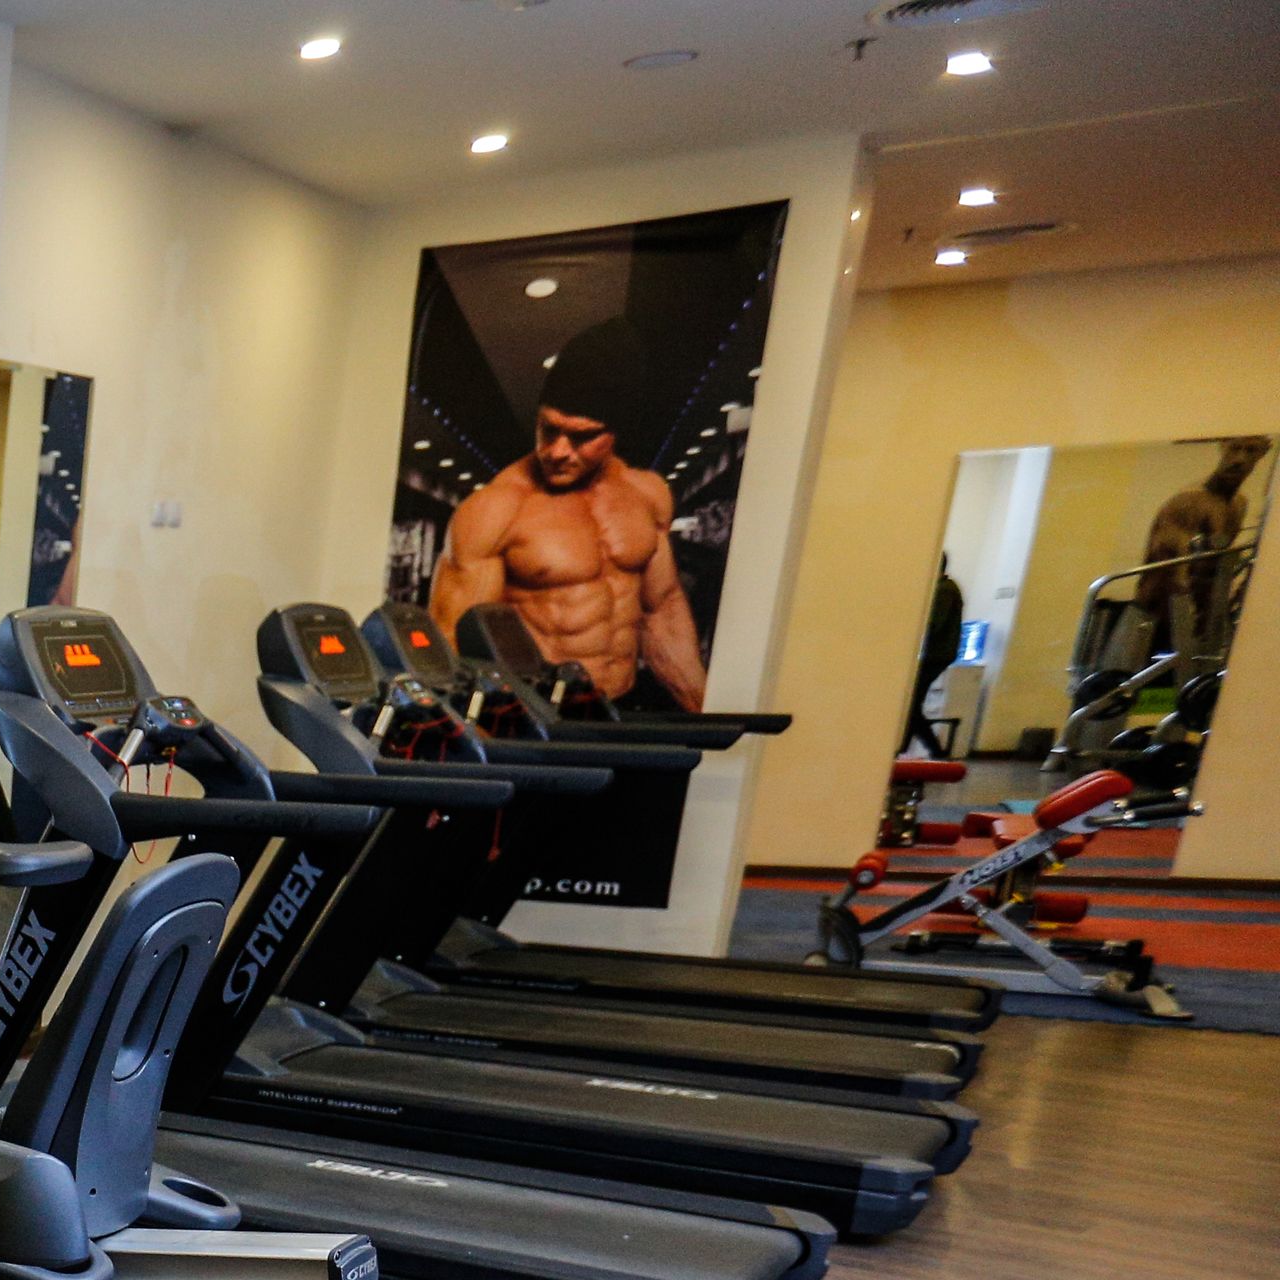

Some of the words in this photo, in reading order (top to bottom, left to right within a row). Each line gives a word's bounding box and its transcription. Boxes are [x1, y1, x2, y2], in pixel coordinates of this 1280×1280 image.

[244, 850, 324, 968] CYBEX
[258, 1089, 324, 1104] INTELLIGENT
[326, 1098, 399, 1115] SUSPENSION
